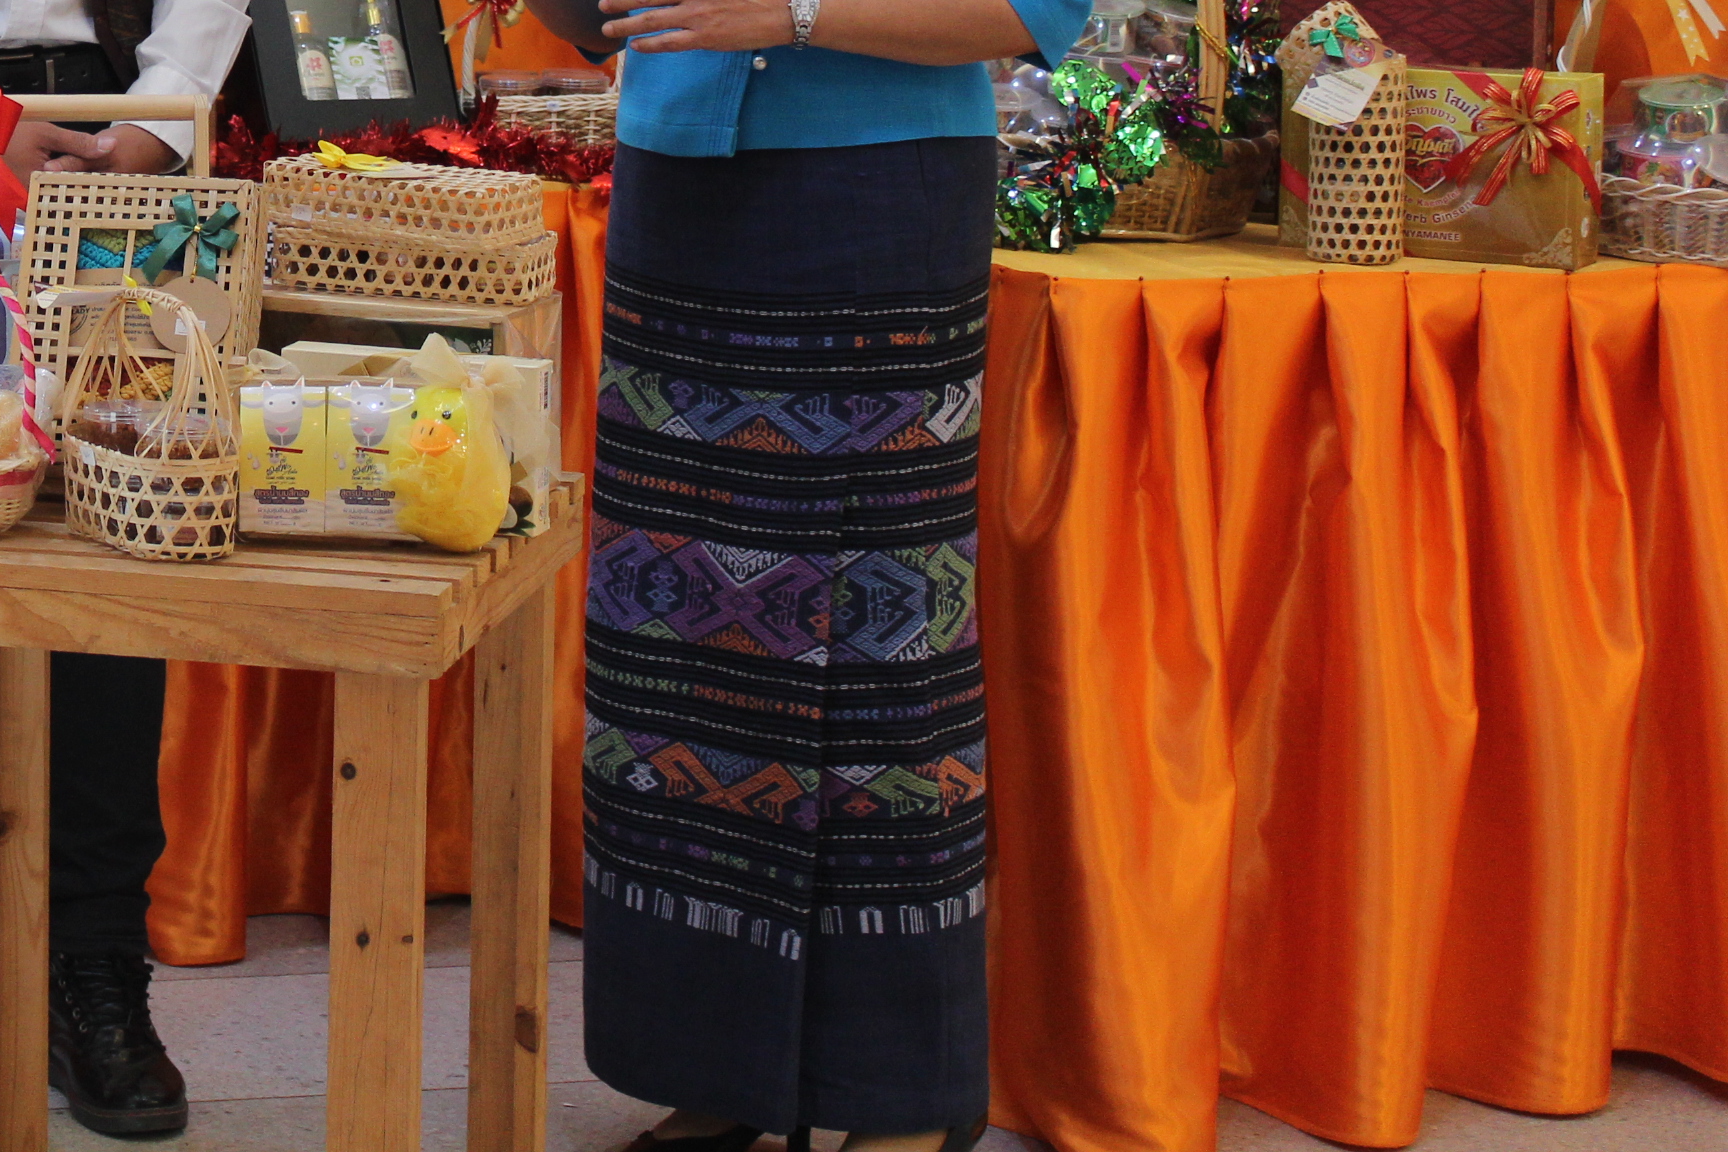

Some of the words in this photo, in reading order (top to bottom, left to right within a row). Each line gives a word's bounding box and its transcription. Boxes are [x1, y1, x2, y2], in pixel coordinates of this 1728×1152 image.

[1405, 85, 1438, 101] ไพร
[1445, 88, 1481, 118] โสมไ
[1405, 106, 1457, 124] ระชายขาว
[1432, 196, 1476, 224] Ginsen
[1403, 229, 1460, 241] NYAMANEE
